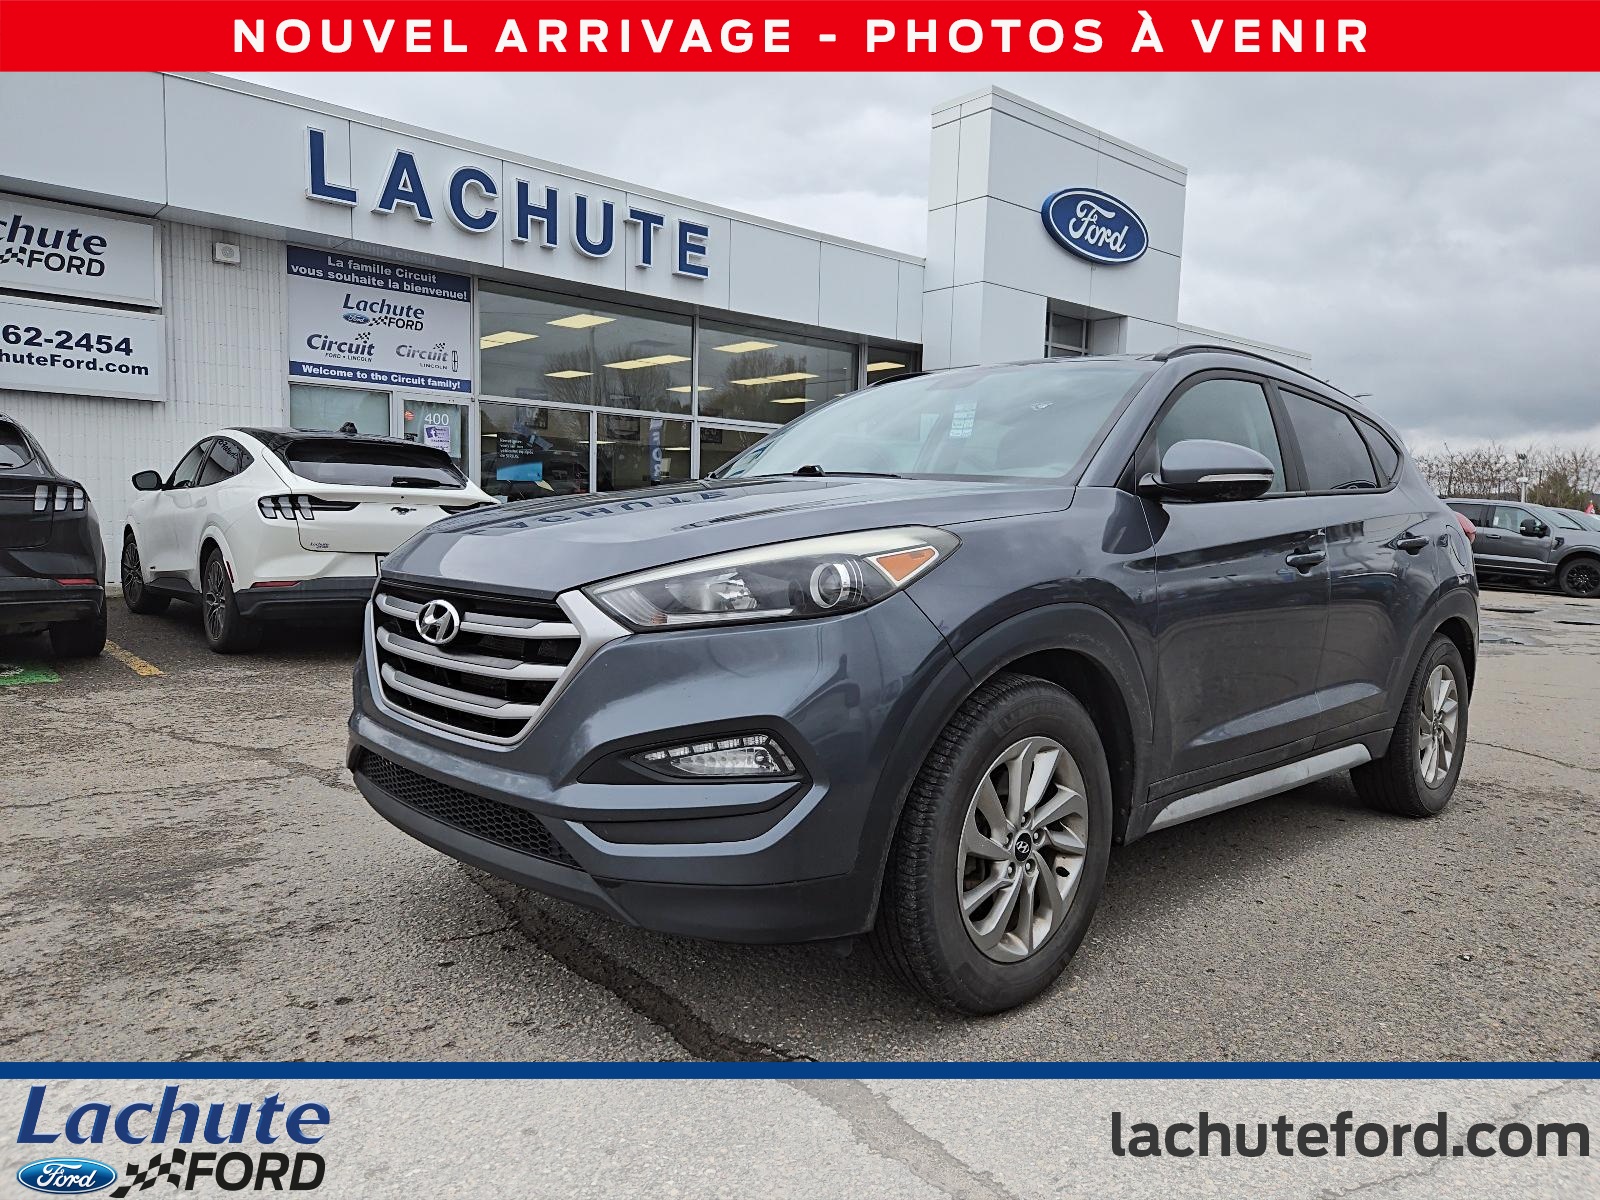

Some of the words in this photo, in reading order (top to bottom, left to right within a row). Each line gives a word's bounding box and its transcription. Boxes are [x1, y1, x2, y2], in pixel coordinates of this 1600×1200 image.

[305, 126, 710, 279] LACHUTE
[1068, 200, 1129, 253] Ford
[27, 250, 105, 277] FORD
[327, 255, 344, 268] La
[347, 260, 392, 276] famille
[395, 268, 437, 284] Circuit
[291, 264, 324, 277] vous
[327, 271, 385, 287] souhaite
[388, 279, 400, 290] la
[403, 281, 467, 300] bienvenue!
[343, 293, 425, 319] Lachute
[387, 317, 424, 331] FORD
[306, 333, 375, 357] Circuit
[395, 344, 449, 362] Circuit
[301, 364, 354, 378] Welcome
[356, 370, 368, 379] to
[370, 372, 388, 382] the
[390, 374, 426, 386] Circuit
[427, 378, 461, 390] family!
[424, 413, 449, 426] 400
